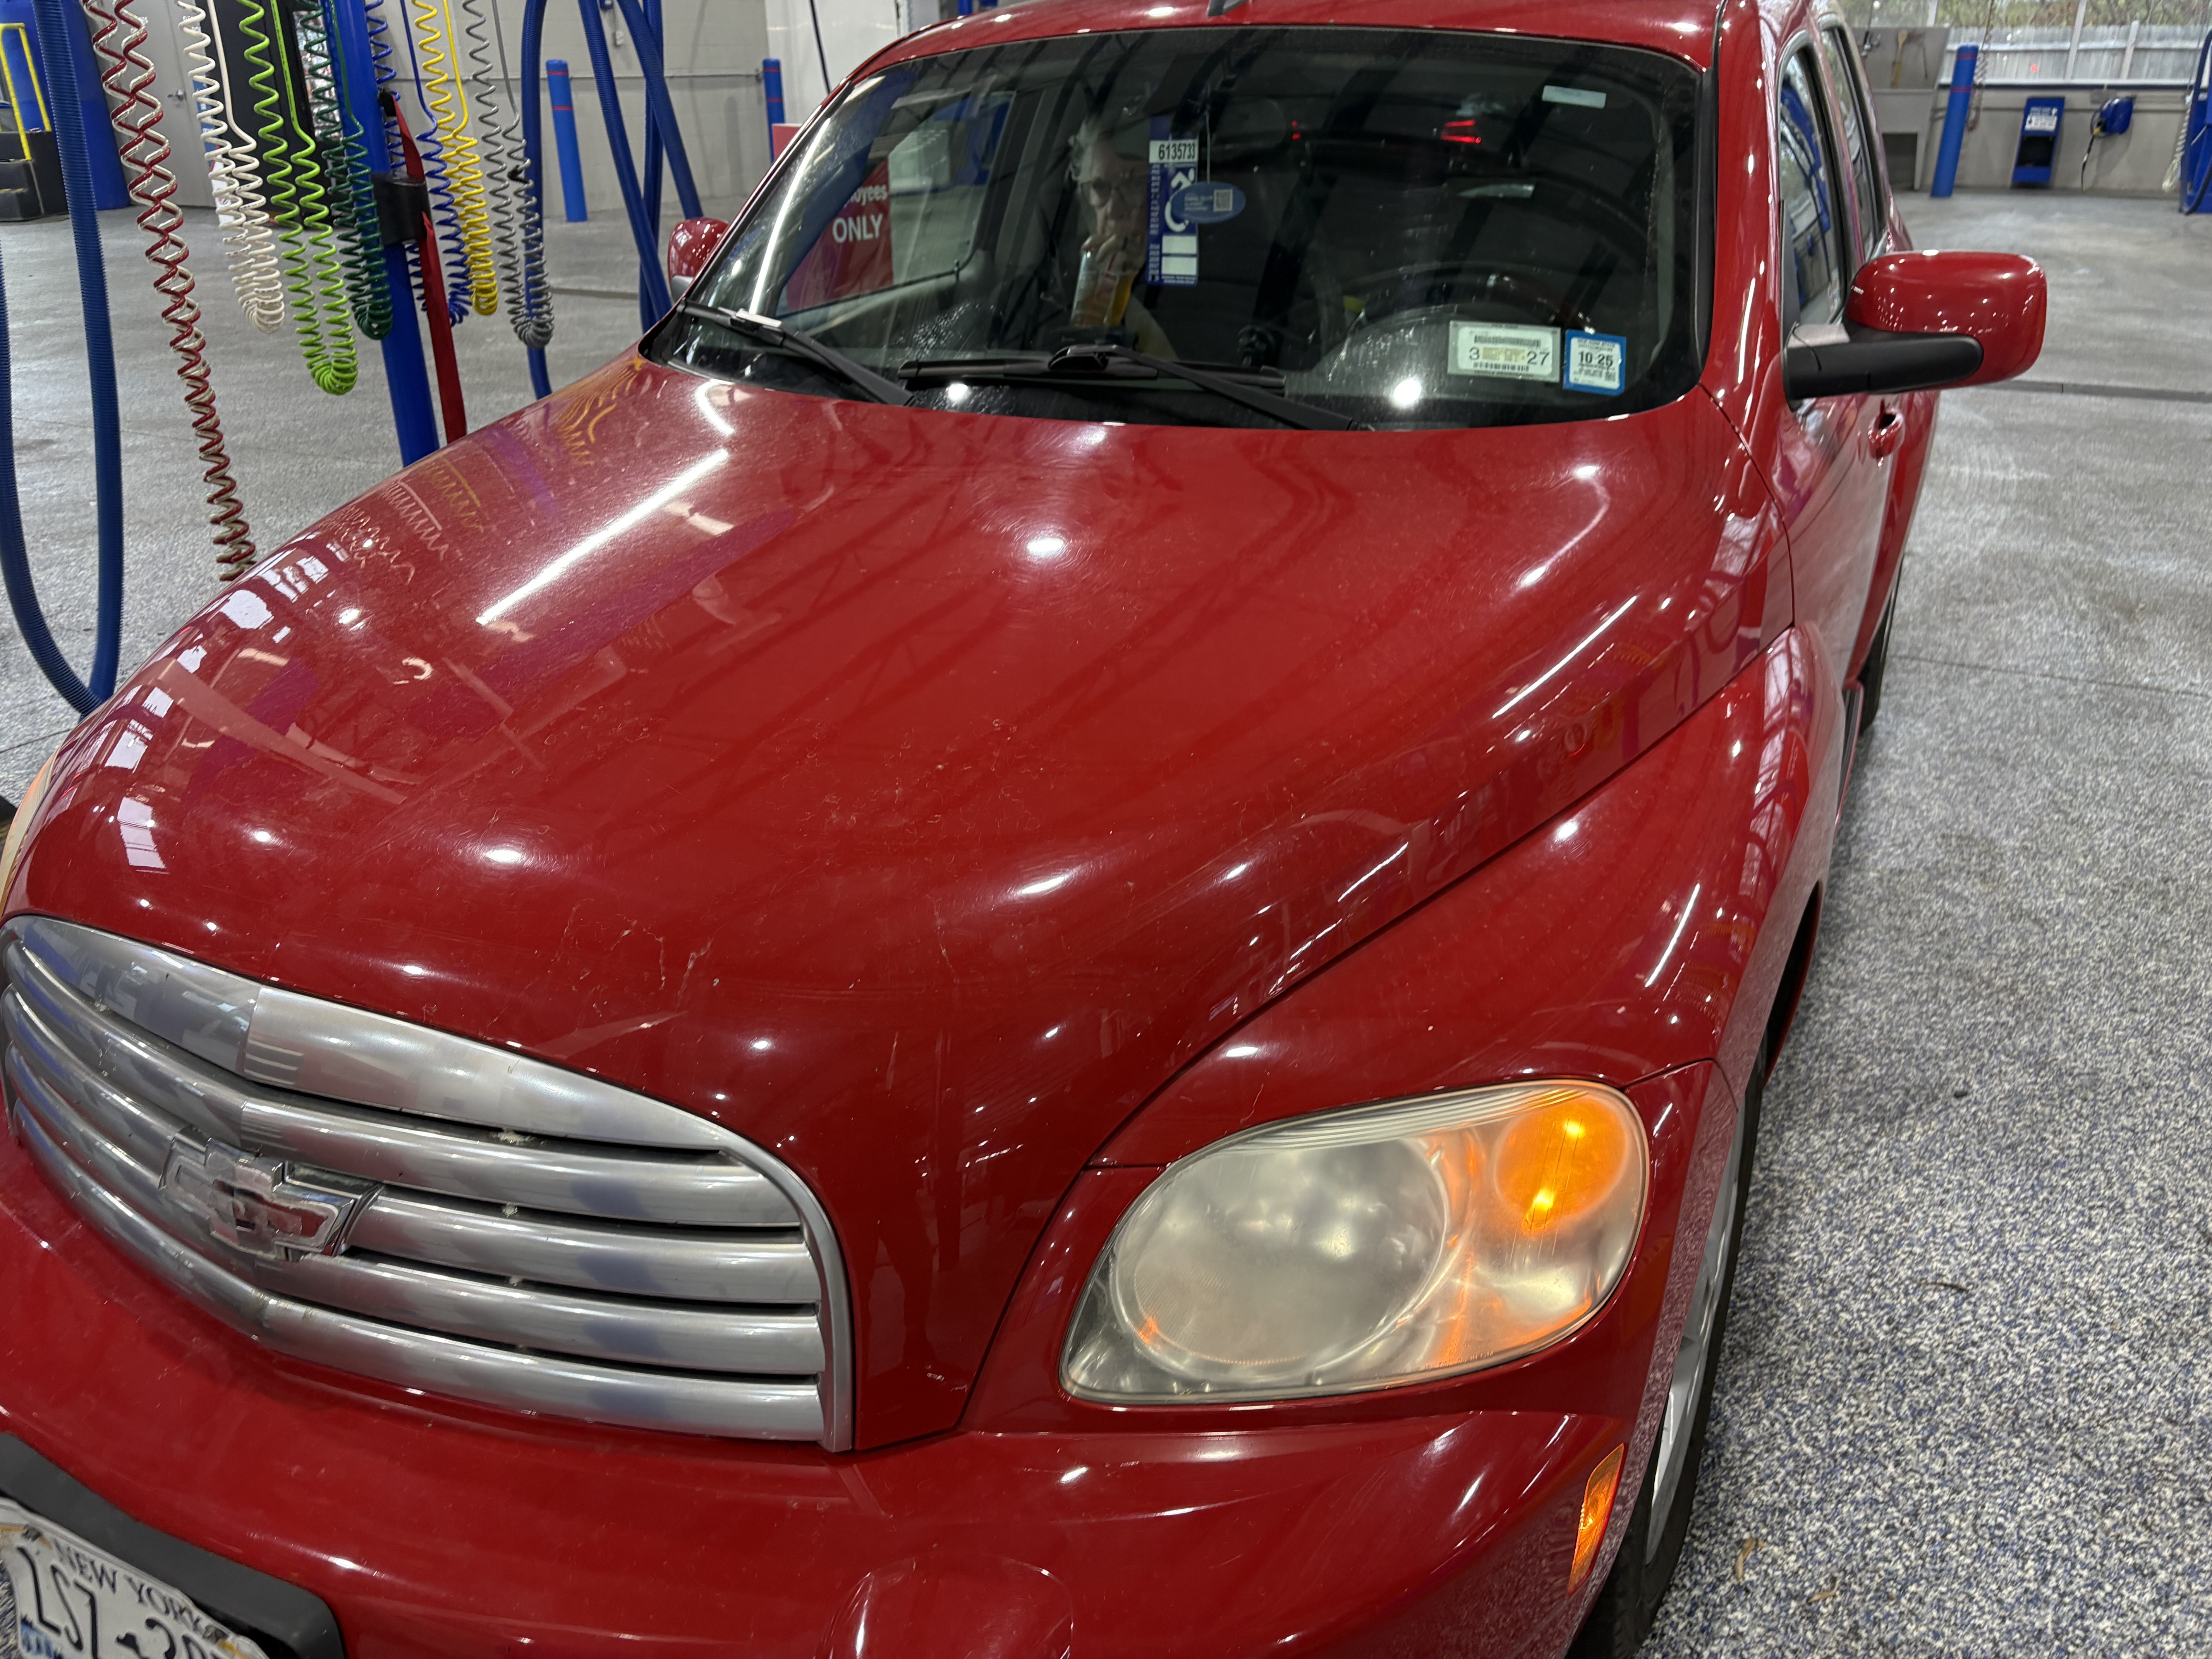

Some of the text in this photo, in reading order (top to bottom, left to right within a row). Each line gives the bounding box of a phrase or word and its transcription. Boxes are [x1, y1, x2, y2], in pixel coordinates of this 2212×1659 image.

[1158, 143, 1195, 160] 6135733
[832, 213, 884, 243] ONLY
[1469, 347, 1550, 366] 3 27
[1578, 351, 1593, 364] 10
[53, 1537, 205, 1635] NEW YORK
